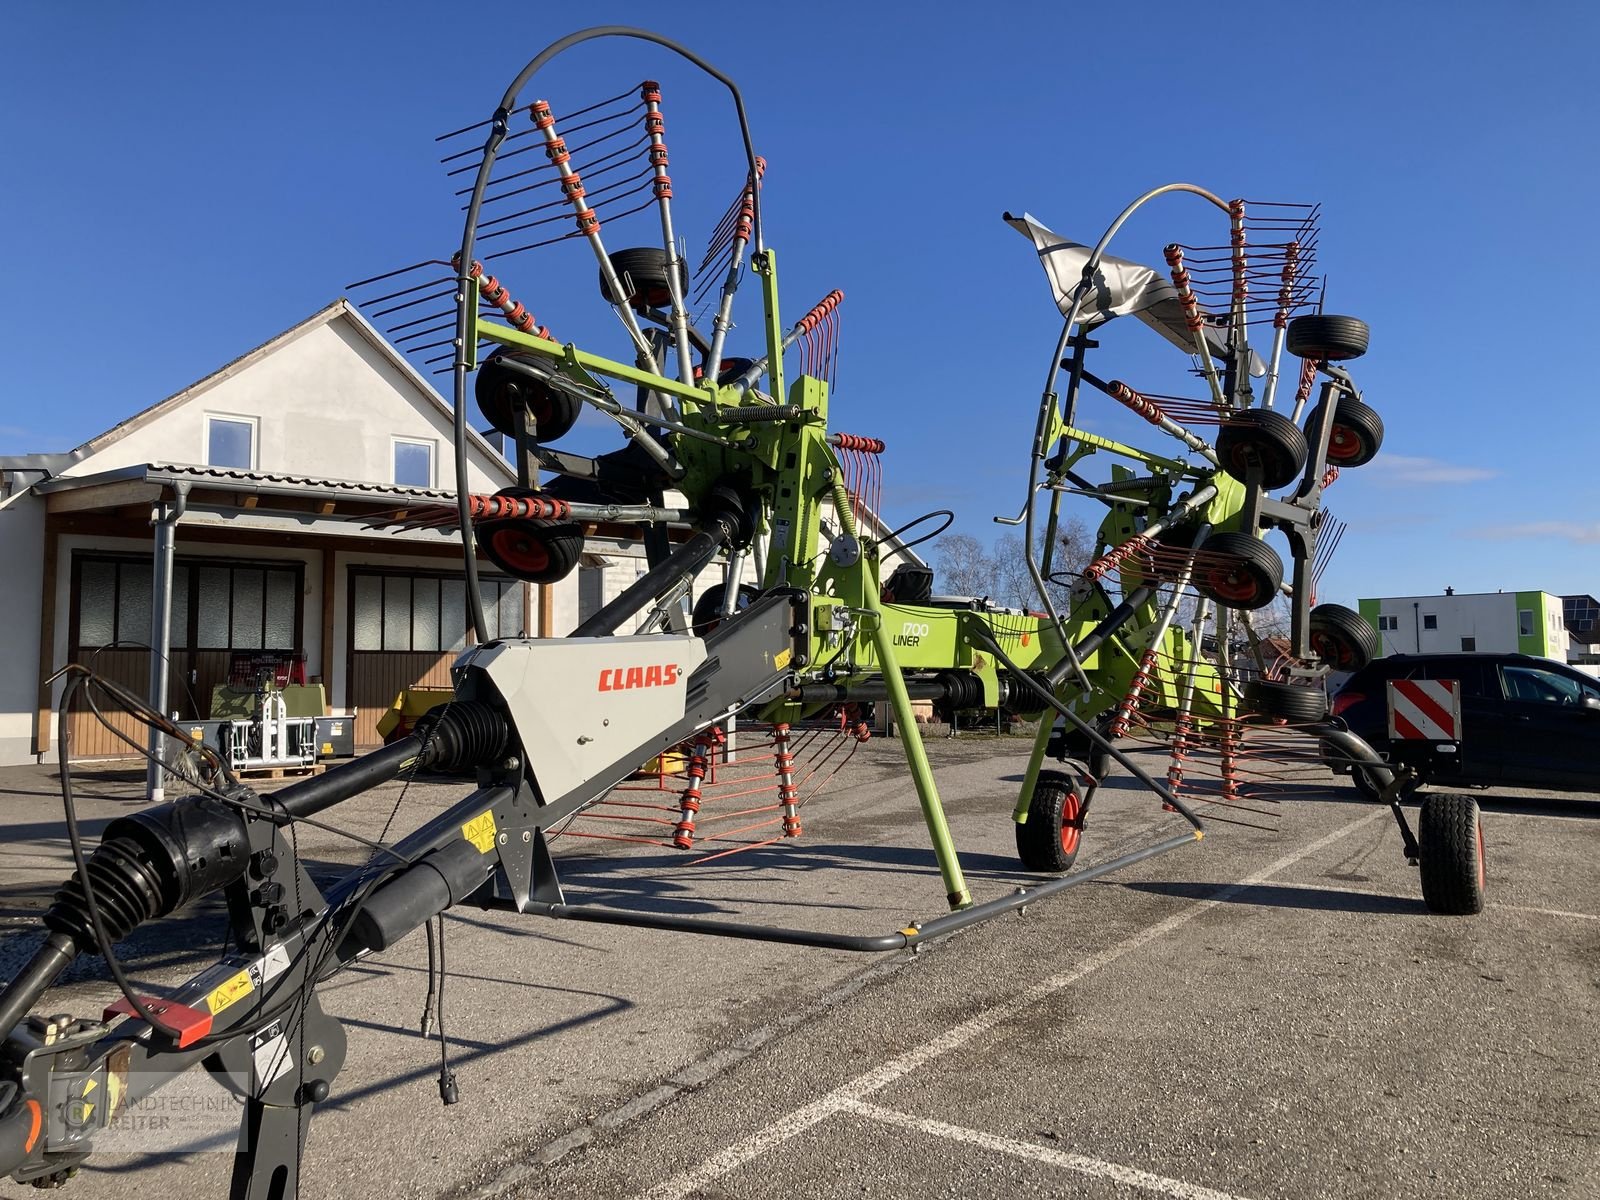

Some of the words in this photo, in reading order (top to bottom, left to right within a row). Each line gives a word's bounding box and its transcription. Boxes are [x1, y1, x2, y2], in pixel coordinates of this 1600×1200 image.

[902, 622, 929, 637] 1700
[893, 634, 920, 646] LINER
[598, 664, 678, 692] CLAAS
